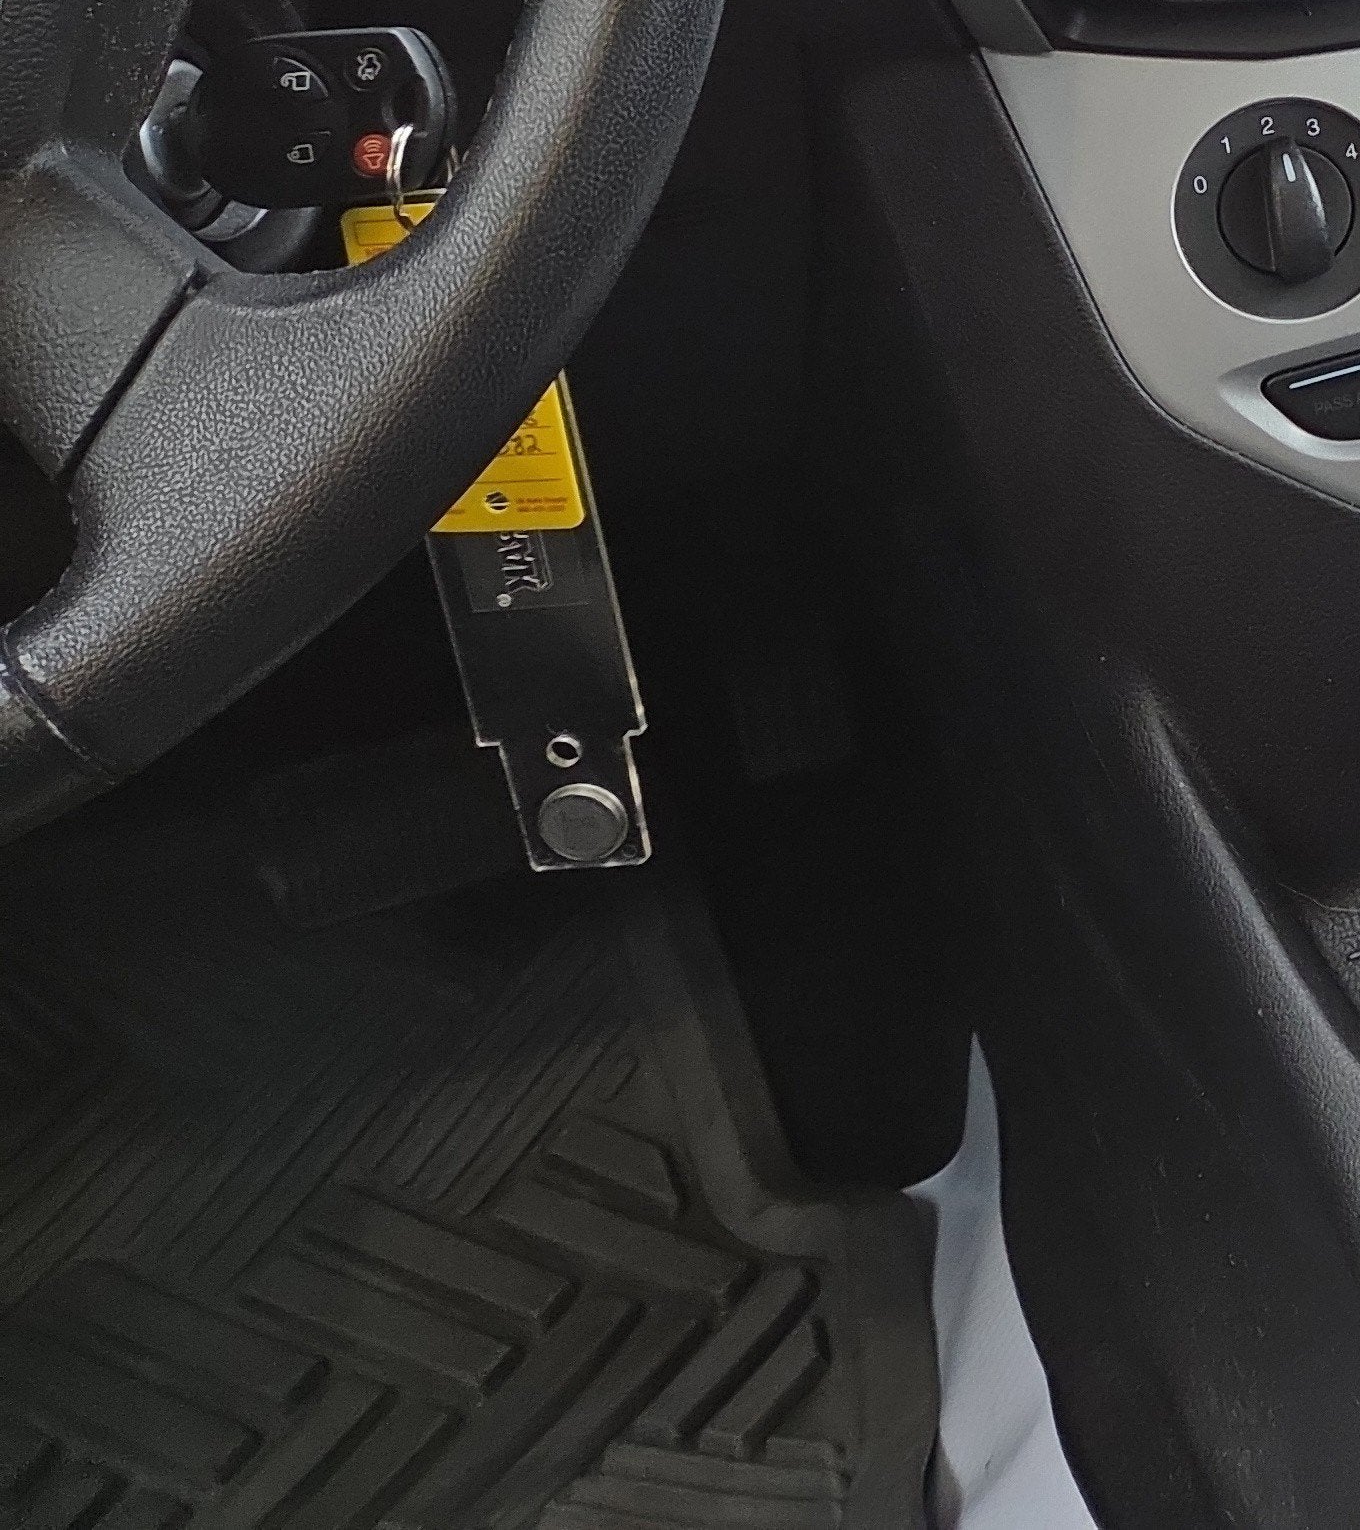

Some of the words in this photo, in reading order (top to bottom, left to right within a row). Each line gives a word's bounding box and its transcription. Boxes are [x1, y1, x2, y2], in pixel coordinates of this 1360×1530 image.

[1260, 116, 1276, 136] 2
[1306, 118, 1321, 137] 3
[1220, 136, 1231, 154] 1
[1345, 142, 1358, 160] 4
[1193, 175, 1208, 194] 0
